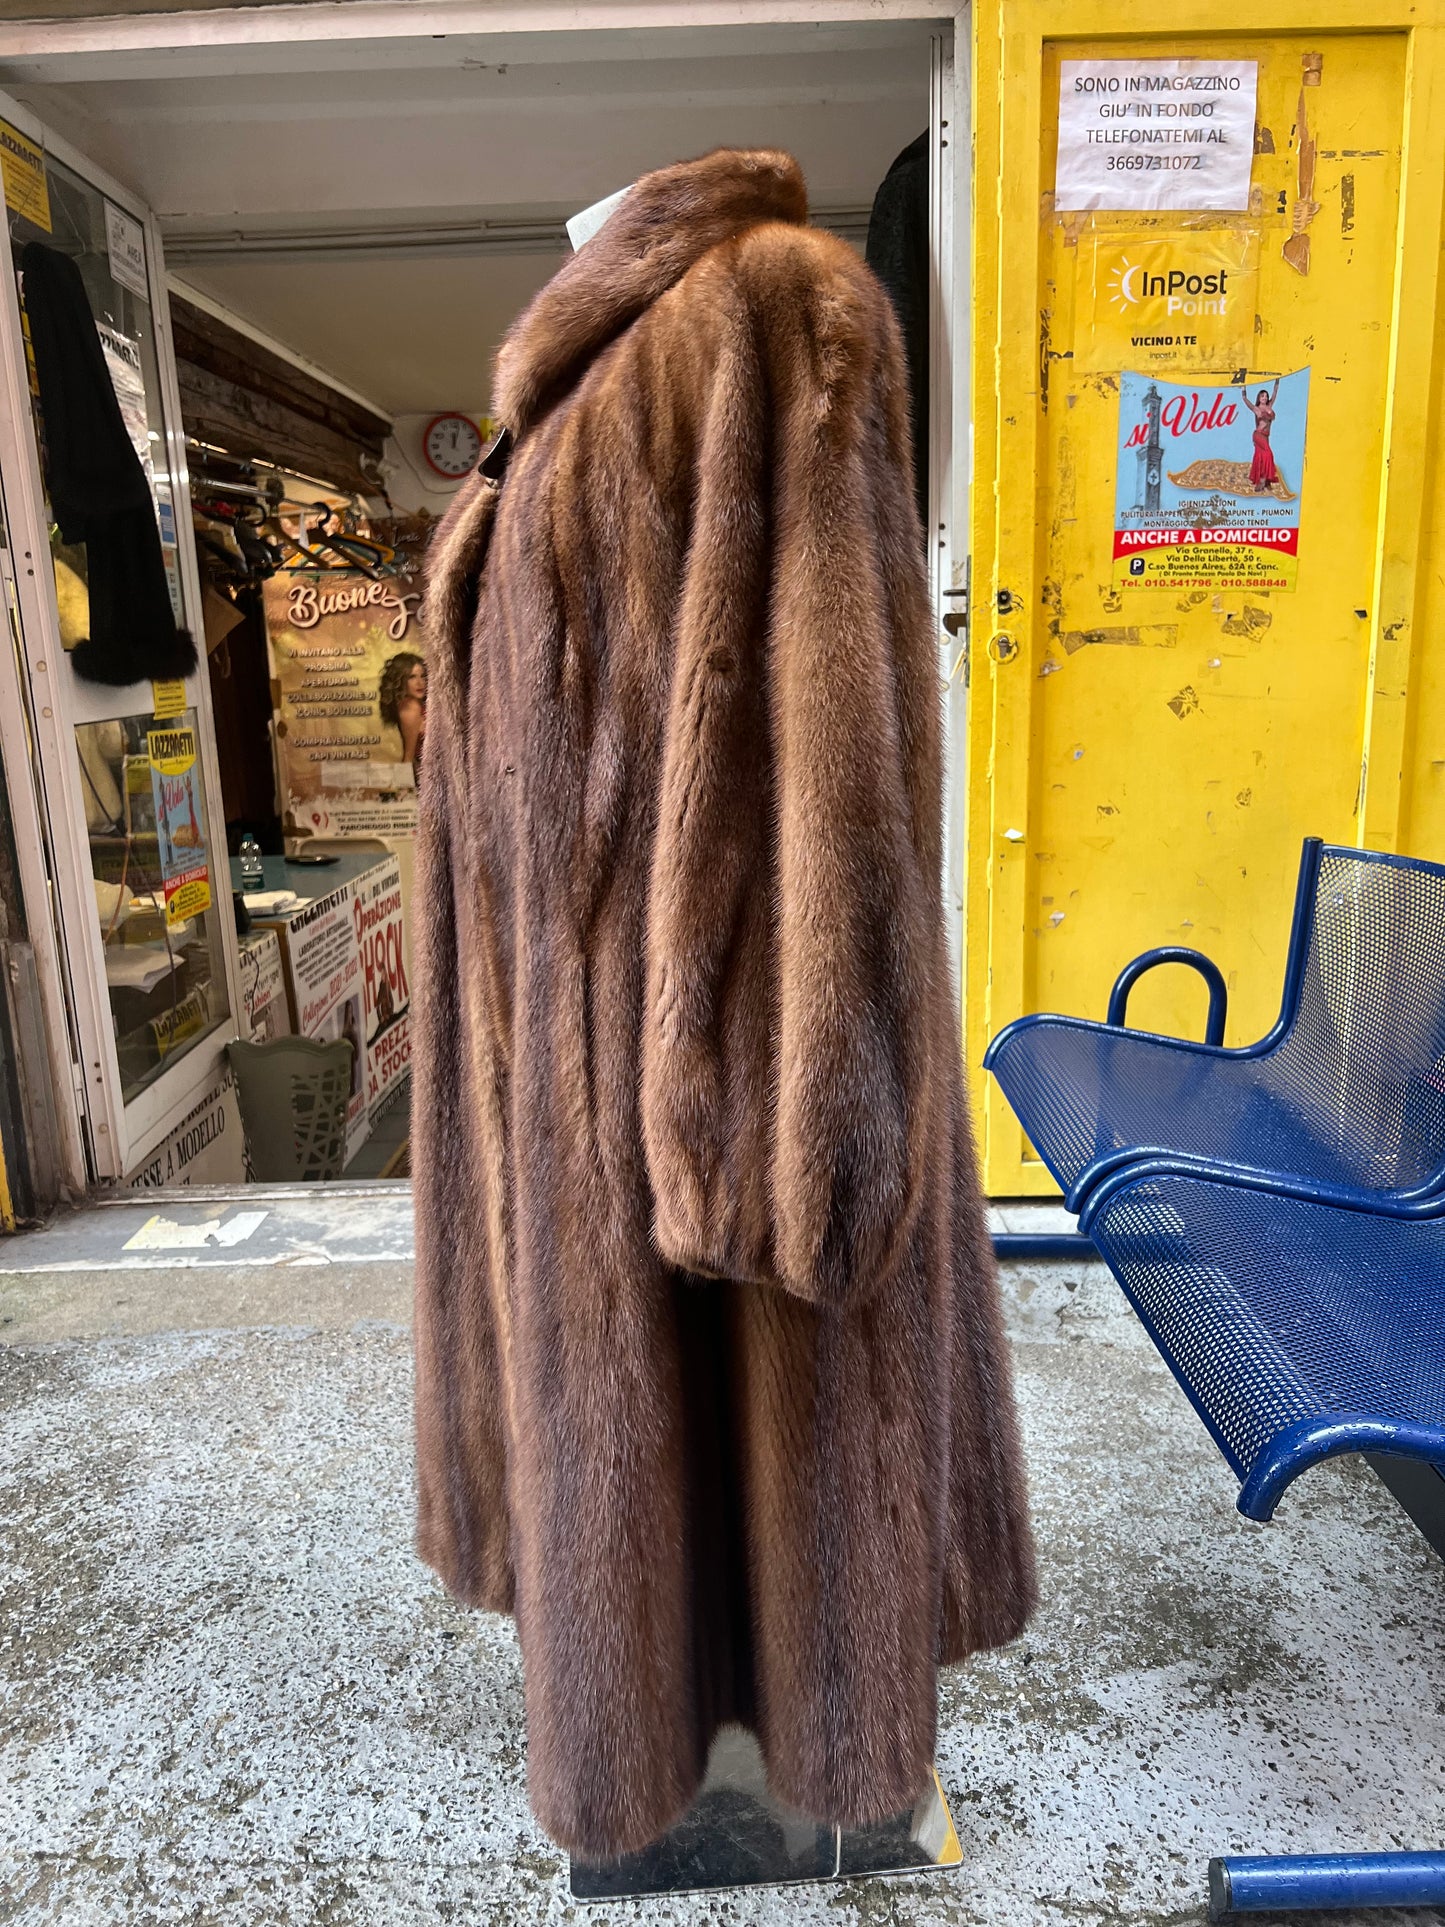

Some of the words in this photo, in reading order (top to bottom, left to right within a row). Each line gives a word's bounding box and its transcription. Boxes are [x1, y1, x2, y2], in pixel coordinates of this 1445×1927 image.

[1074, 77, 1119, 92] SONO
[1124, 76, 1141, 92] IN
[1145, 76, 1241, 92] MAGAZZINO
[1136, 103, 1152, 118] IN
[1157, 102, 1214, 117] FONDO
[1086, 129, 1203, 144] TELEFONATEMI
[1206, 128, 1226, 143] AL
[1106, 155, 1201, 171] 3669731072
[1142, 269, 1229, 297] InPost
[1167, 297, 1227, 316] Point
[1131, 336, 1173, 347] VICINO
[1175, 336, 1182, 346] A
[1183, 335, 1197, 346] TE
[1160, 392, 1239, 438] Vola
[1261, 509, 1293, 517] PIUMONI
[1120, 531, 1179, 545] ANCHE
[1183, 530, 1196, 544] A
[1200, 529, 1291, 544] DOMICILIO
[1175, 546, 1190, 554] Via
[1235, 546, 1246, 554] 37
[1166, 555, 1181, 563] Via
[1183, 554, 1206, 562] Della
[1120, 579, 1140, 588] Tel.
[1144, 579, 1212, 588] 010.541796
[1221, 579, 1287, 588] 010.588848
[176, 1105, 225, 1170] MODELLO
